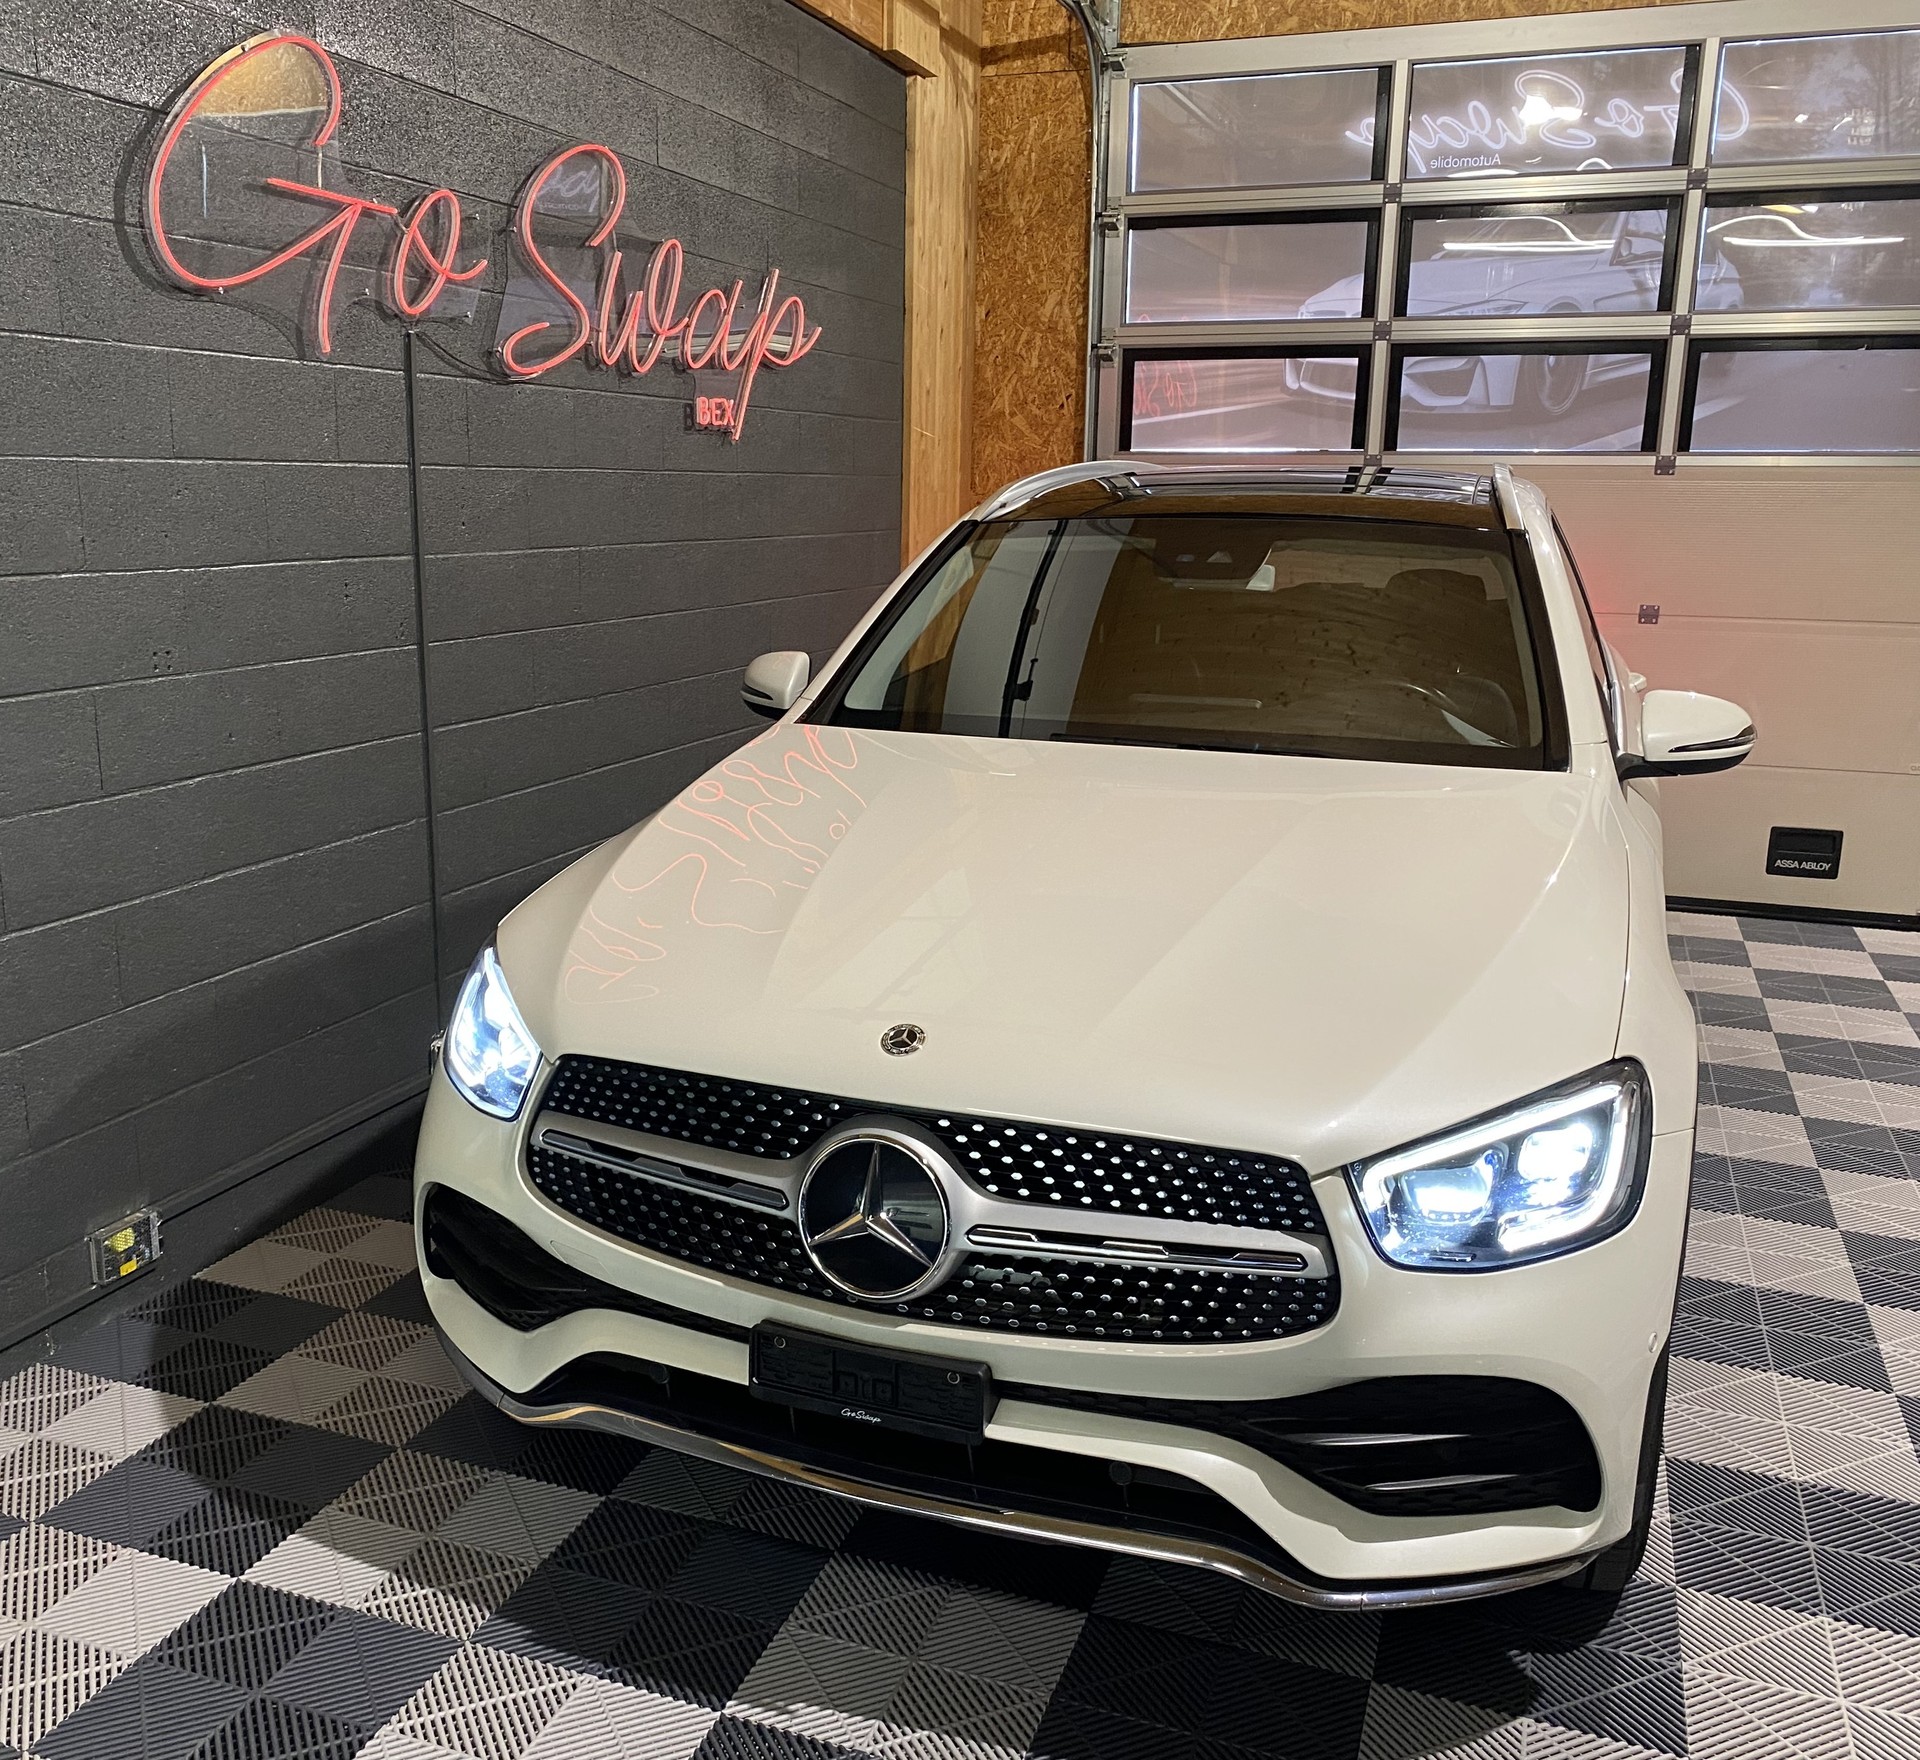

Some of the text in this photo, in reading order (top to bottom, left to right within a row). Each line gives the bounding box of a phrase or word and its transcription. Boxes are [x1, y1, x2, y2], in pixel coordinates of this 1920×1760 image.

[151, 35, 822, 441] Go Swap
[696, 396, 735, 426] BEX
[1774, 859, 1831, 871] ASSA ABLOY
